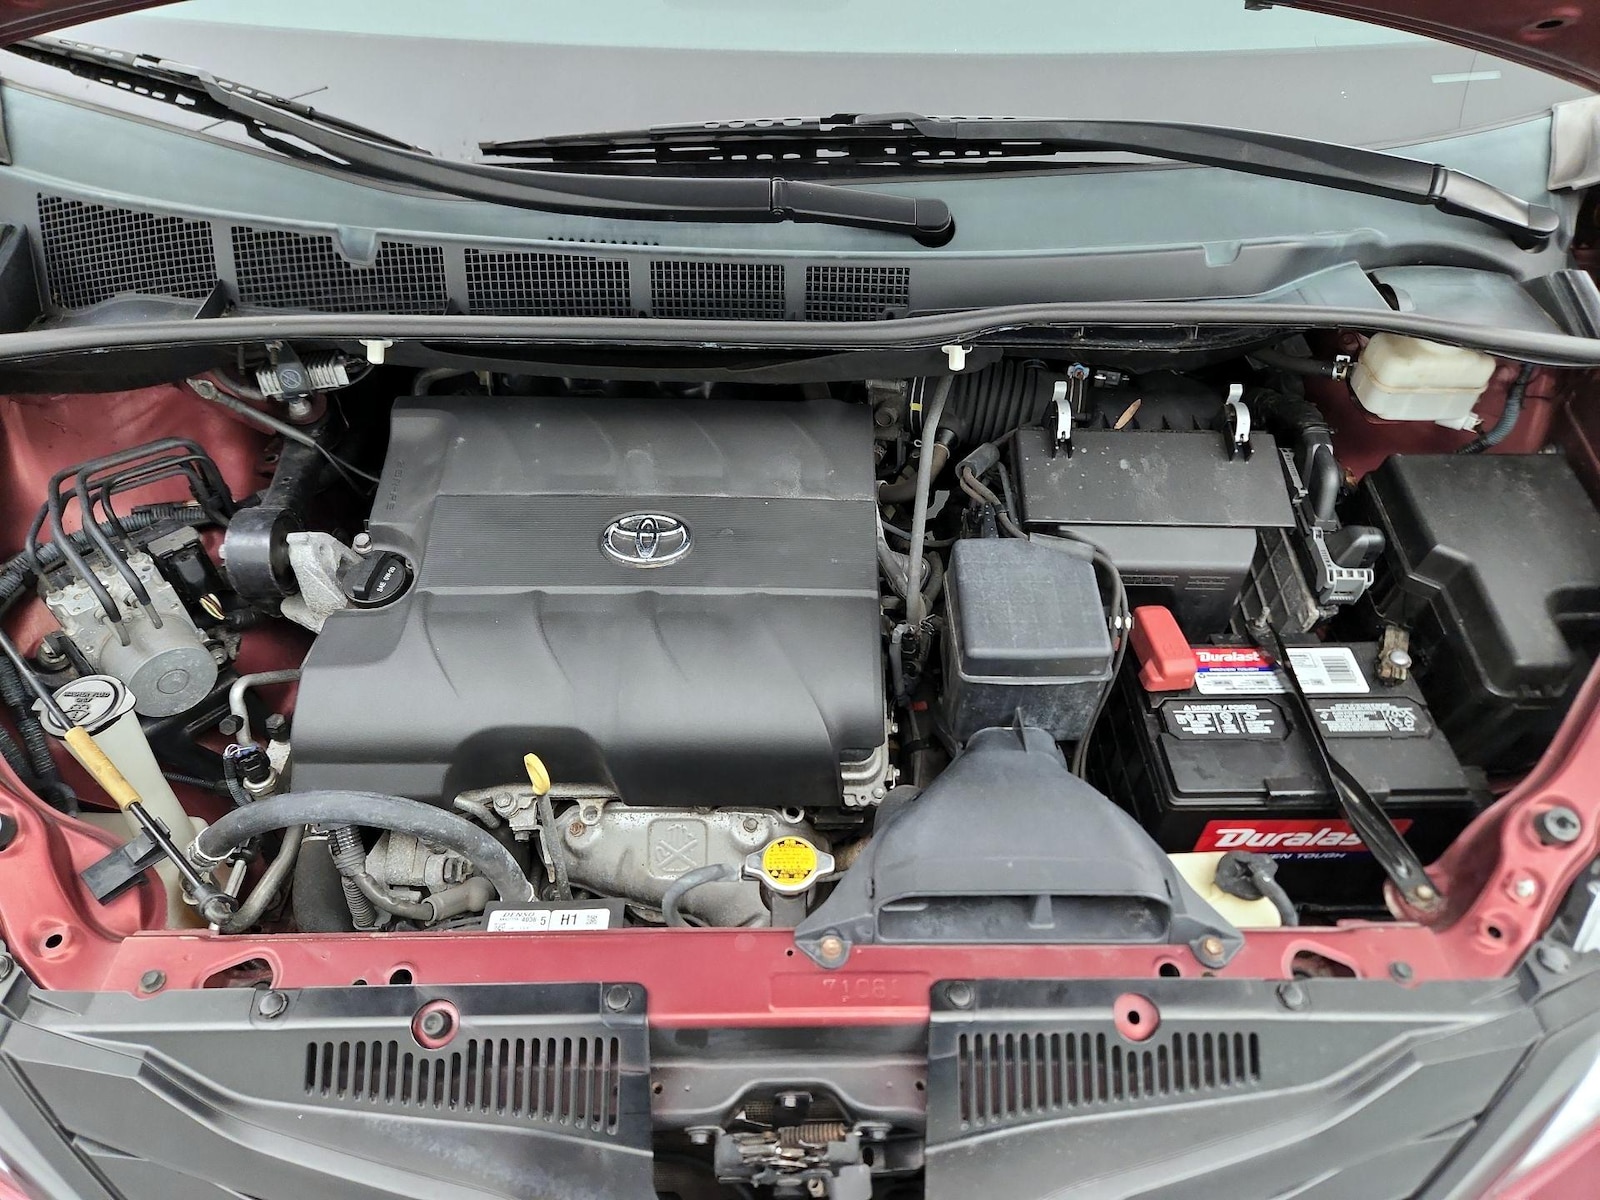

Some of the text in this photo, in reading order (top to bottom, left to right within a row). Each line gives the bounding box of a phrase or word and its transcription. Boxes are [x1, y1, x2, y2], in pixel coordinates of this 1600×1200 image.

[376, 581, 387, 592] SAE
[1195, 651, 1260, 662] Duralast
[1214, 828, 1362, 847] Duralas
[540, 916, 547, 926] 5
[560, 913, 578, 926] H1
